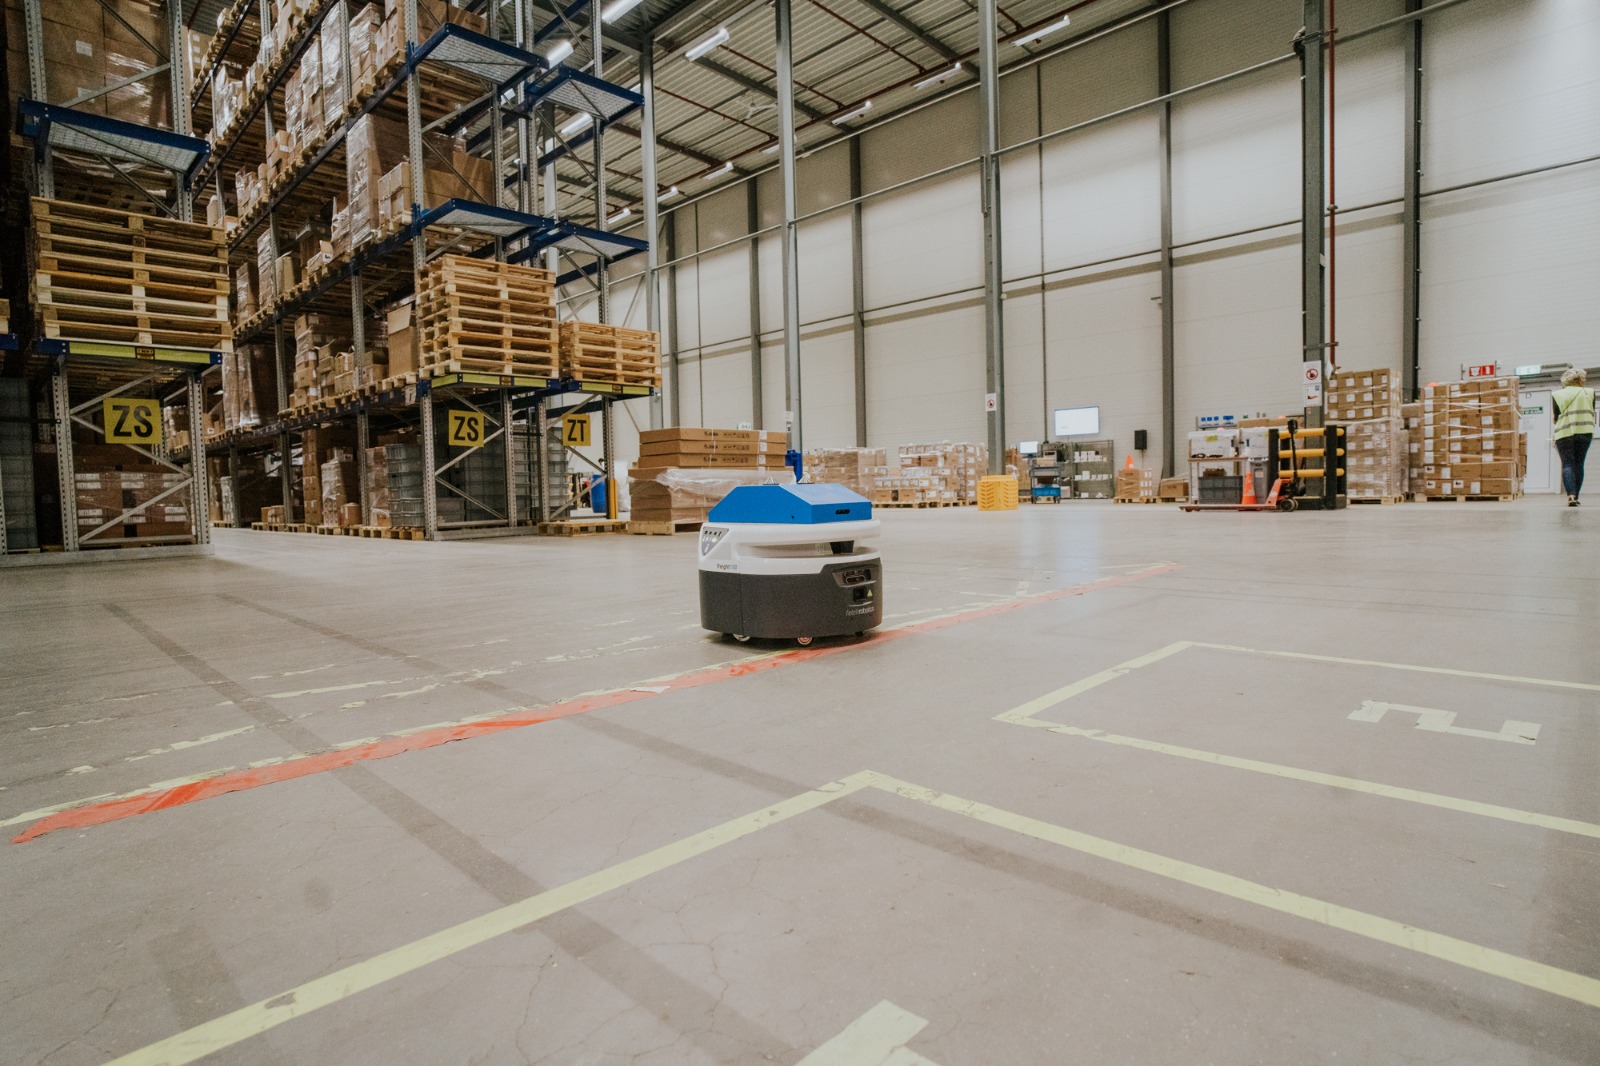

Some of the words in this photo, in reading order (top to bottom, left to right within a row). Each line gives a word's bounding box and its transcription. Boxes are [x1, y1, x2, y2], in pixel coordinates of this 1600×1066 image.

[112, 405, 153, 438] ZS
[453, 415, 479, 442] ZS
[567, 419, 587, 442] ZT
